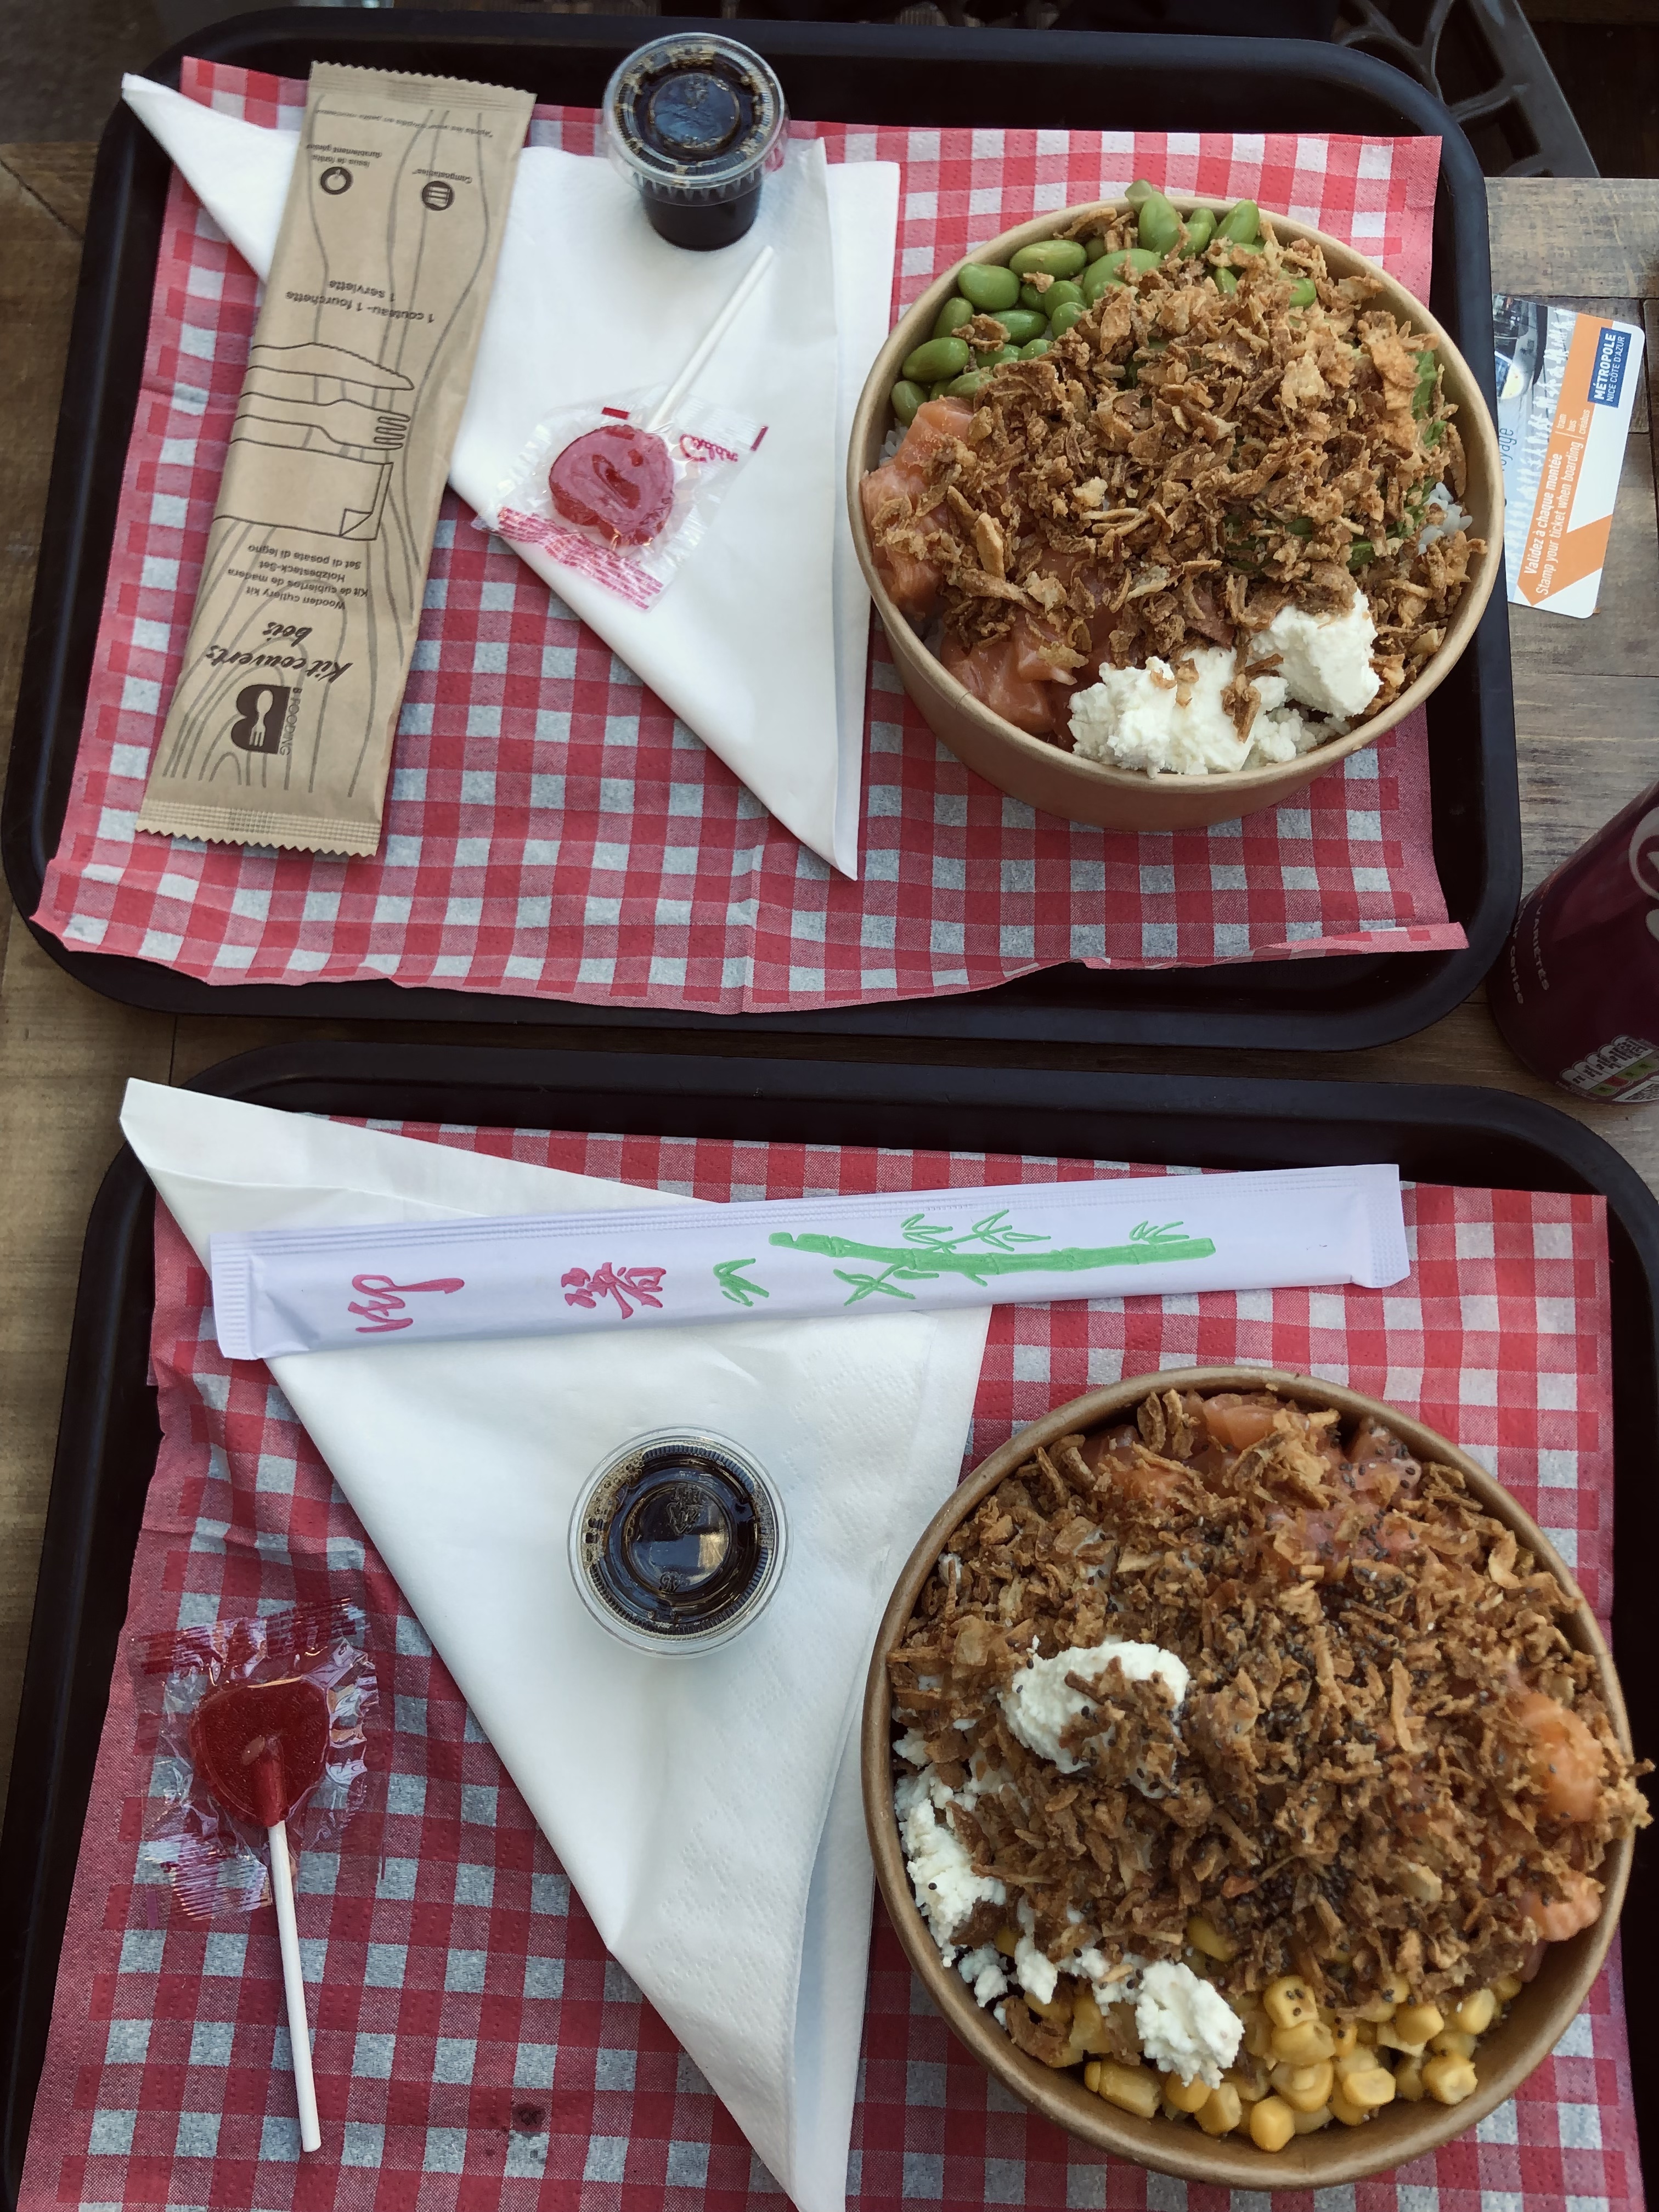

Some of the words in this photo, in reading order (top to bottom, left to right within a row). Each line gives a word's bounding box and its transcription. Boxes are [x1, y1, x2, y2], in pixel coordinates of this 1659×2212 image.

[328, 280, 386, 300] serviette
[390, 293, 396, 302] 1
[285, 291, 352, 311] fourchette
[356, 302, 363, 312] 1
[427, 313, 435, 324] 1
[1612, 336, 1626, 363] D'AZUR
[1593, 334, 1617, 399] MÉTROPOLE
[1609, 364, 1621, 383] CÔTE
[1606, 383, 1617, 403] NICE
[1556, 414, 1567, 429] tram
[1567, 420, 1577, 432] bus
[1576, 409, 1590, 435] créabus
[1499, 428, 1517, 471] oyage
[1543, 453, 1563, 491] montée
[1561, 442, 1584, 482] boarding
[1555, 484, 1572, 509] when
[1536, 492, 1556, 528] chaque
[1533, 528, 1546, 537] à
[1549, 511, 1567, 538] ticket
[247, 545, 278, 557] legno
[280, 550, 291, 558] di
[294, 552, 330, 565] posate
[1523, 538, 1545, 574] Validez
[1544, 540, 1560, 562] your
[258, 561, 345, 582] Holzbesteck-Set
[332, 559, 342, 568] di
[345, 561, 362, 570] Set
[228, 568, 268, 583] madera
[270, 577, 284, 587] de
[1535, 563, 1556, 595] Stamp
[246, 586, 261, 596] kit
[263, 589, 300, 604] cutlery
[287, 580, 337, 594] cubiertos
[353, 588, 369, 597] Kit
[302, 597, 346, 610] Wooden
[262, 622, 313, 647] bois
[205, 644, 307, 670] couverts
[306, 660, 353, 684] Kit
[279, 698, 301, 756] FOODING
